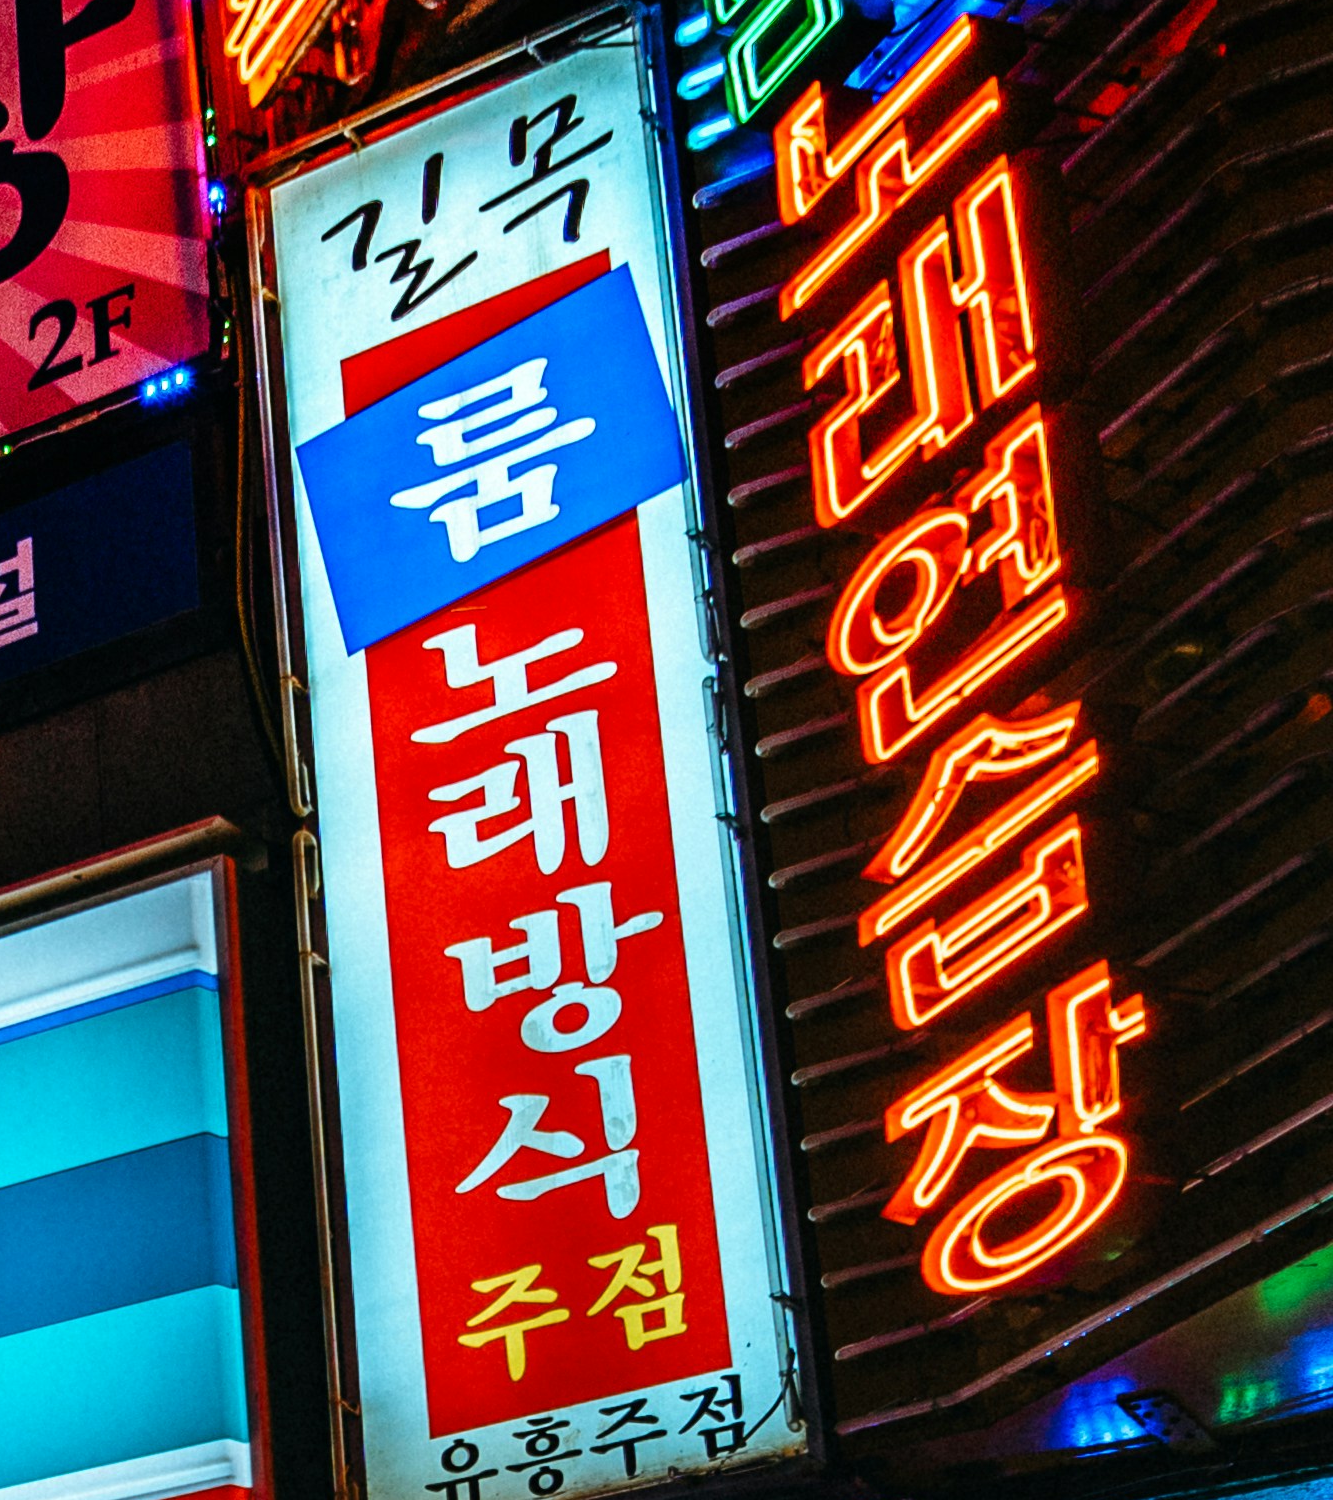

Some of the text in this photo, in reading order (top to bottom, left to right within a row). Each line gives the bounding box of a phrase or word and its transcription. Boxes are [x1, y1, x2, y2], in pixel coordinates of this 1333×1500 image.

[323, 93, 614, 322] 길목
[26, 284, 135, 392] 2F
[389, 354, 598, 564] 룸
[774, 12, 1146, 1298] 노래연습장
[456, 1222, 687, 1384] 주점
